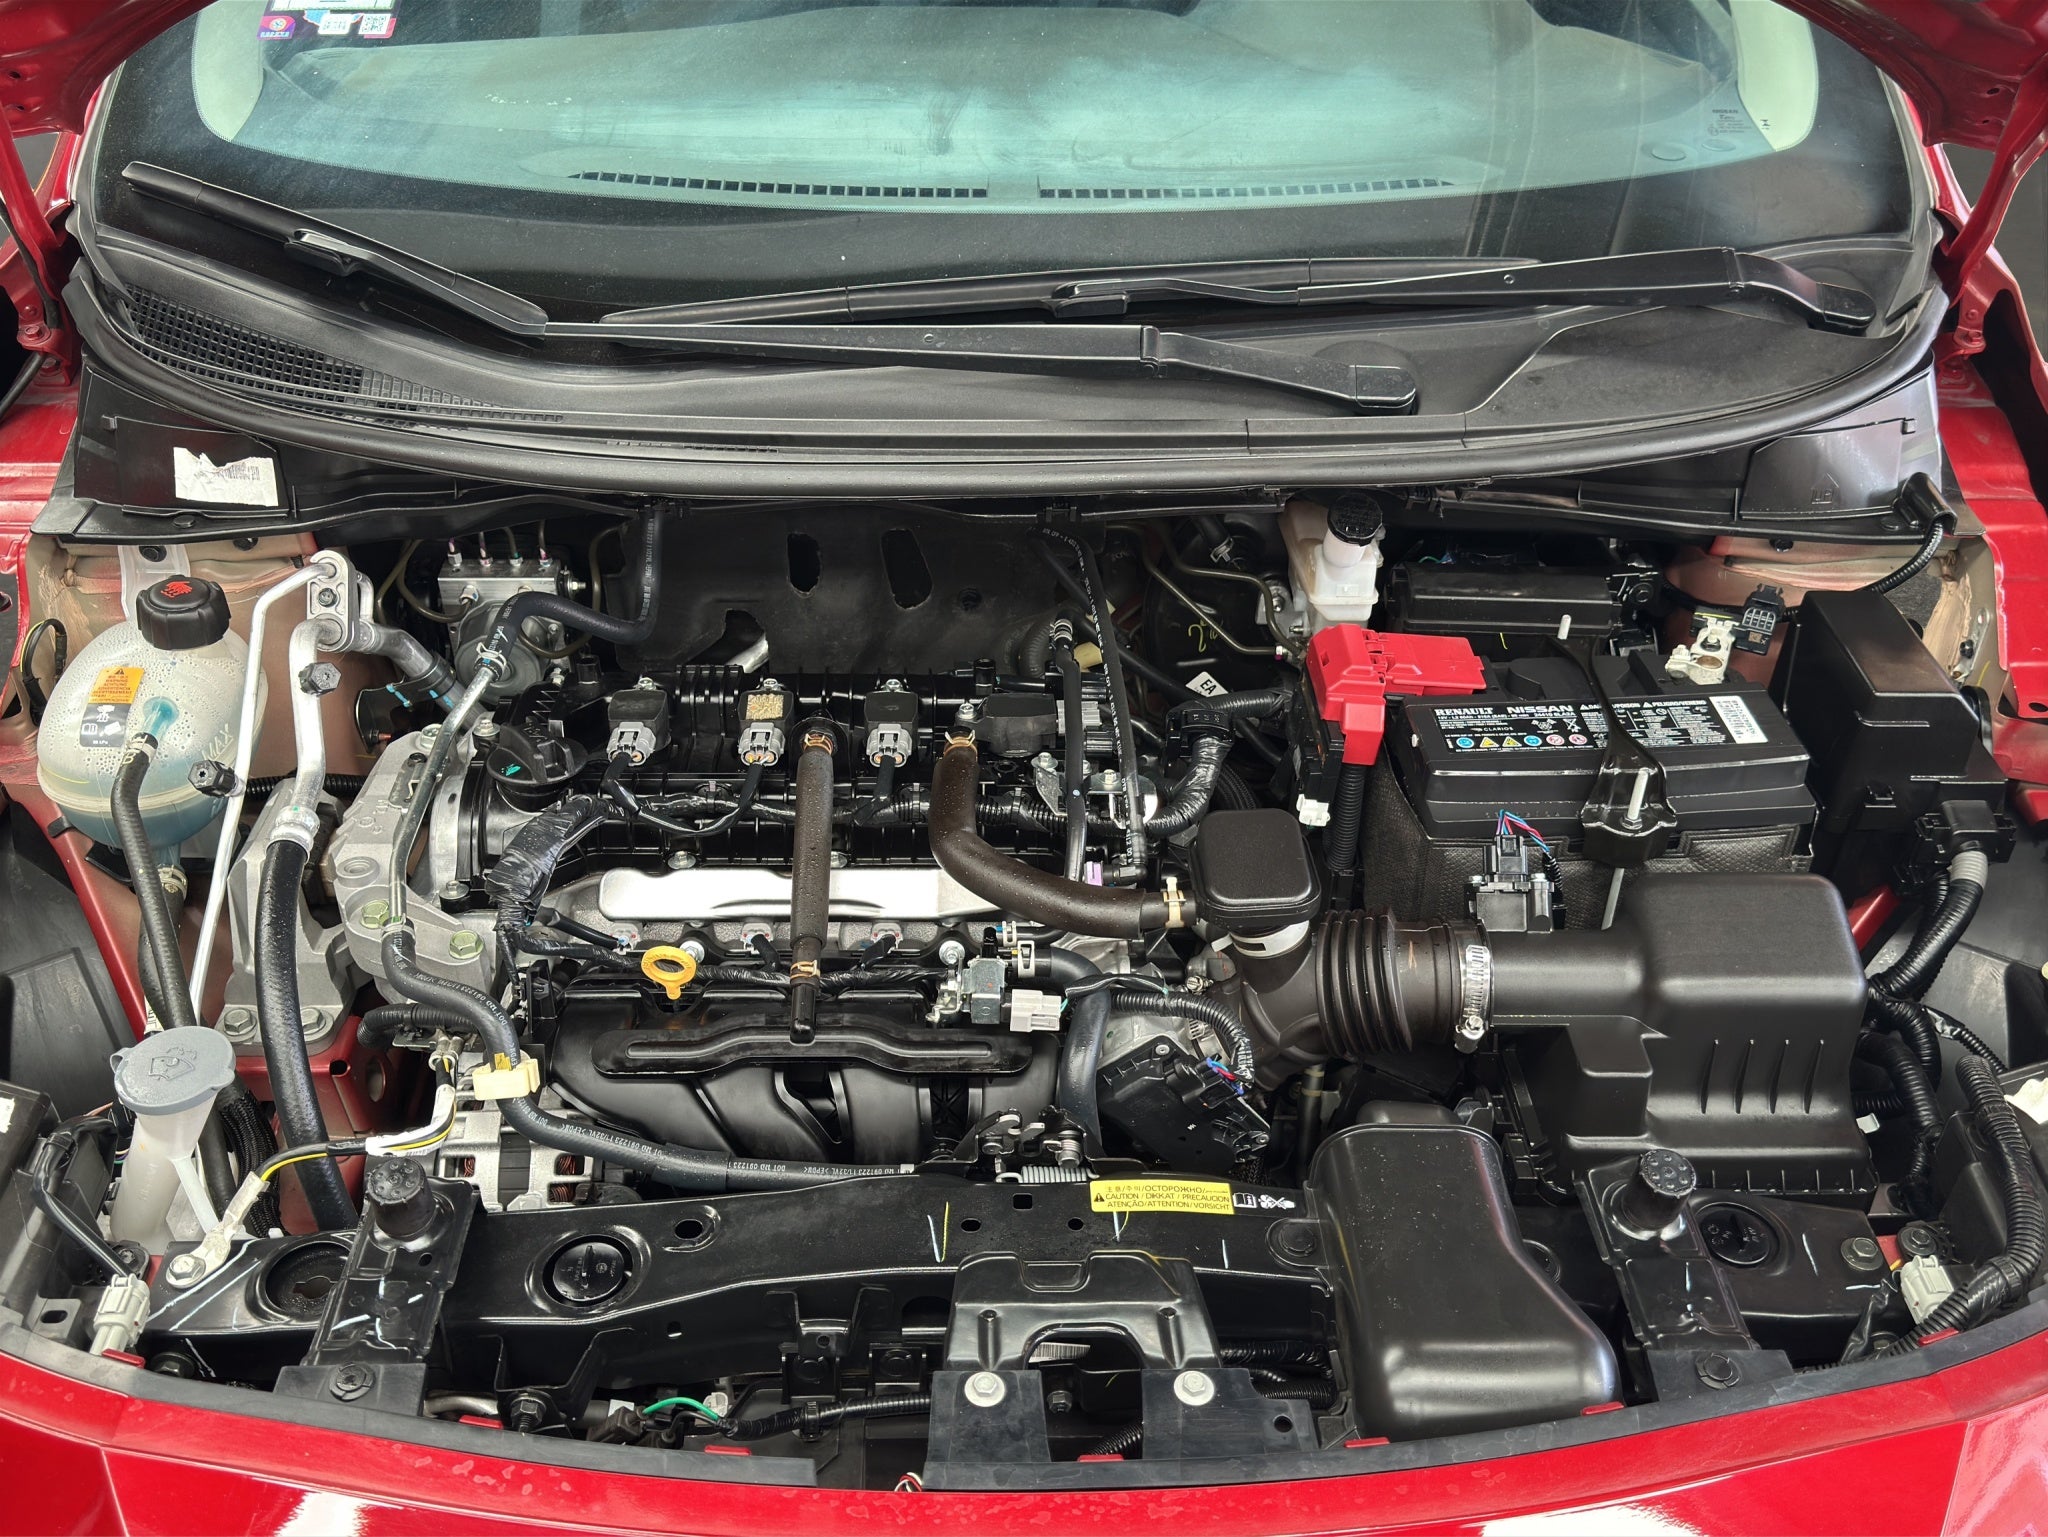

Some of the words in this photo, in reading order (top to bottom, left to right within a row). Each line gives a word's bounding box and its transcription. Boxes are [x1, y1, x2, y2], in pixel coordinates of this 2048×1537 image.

[1200, 679, 1217, 695] EA
[1434, 707, 1494, 716] RENAULT
[1506, 705, 1574, 714] NISSAN
[733, 1161, 759, 1170] 091223
[771, 1164, 787, 1172] DOT
[1145, 1192, 1175, 1200] DIKKAT
